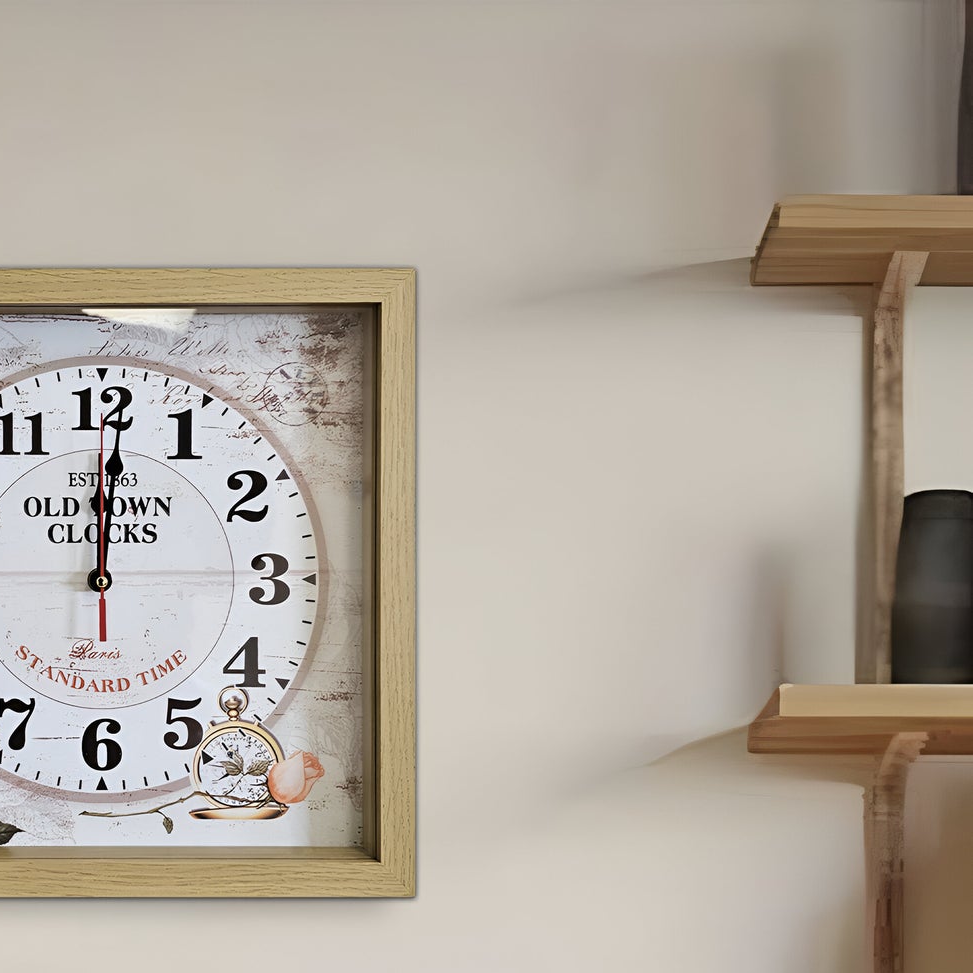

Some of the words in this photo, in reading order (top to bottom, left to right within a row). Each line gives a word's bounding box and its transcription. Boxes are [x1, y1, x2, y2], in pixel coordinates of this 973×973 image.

[71, 386, 134, 431] 12
[167, 409, 203, 460] 1
[23, 496, 80, 518] OLD
[88, 496, 173, 518] OWN
[226, 470, 269, 522] 2
[47, 523, 158, 544] CLOCKS
[249, 553, 291, 606] 3
[15, 645, 131, 693] STANDARD
[135, 649, 188, 687] TIME
[68, 639, 123, 661] Paris
[222, 637, 266, 688] 4
[81, 719, 123, 772] 6
[163, 697, 204, 751] 5
